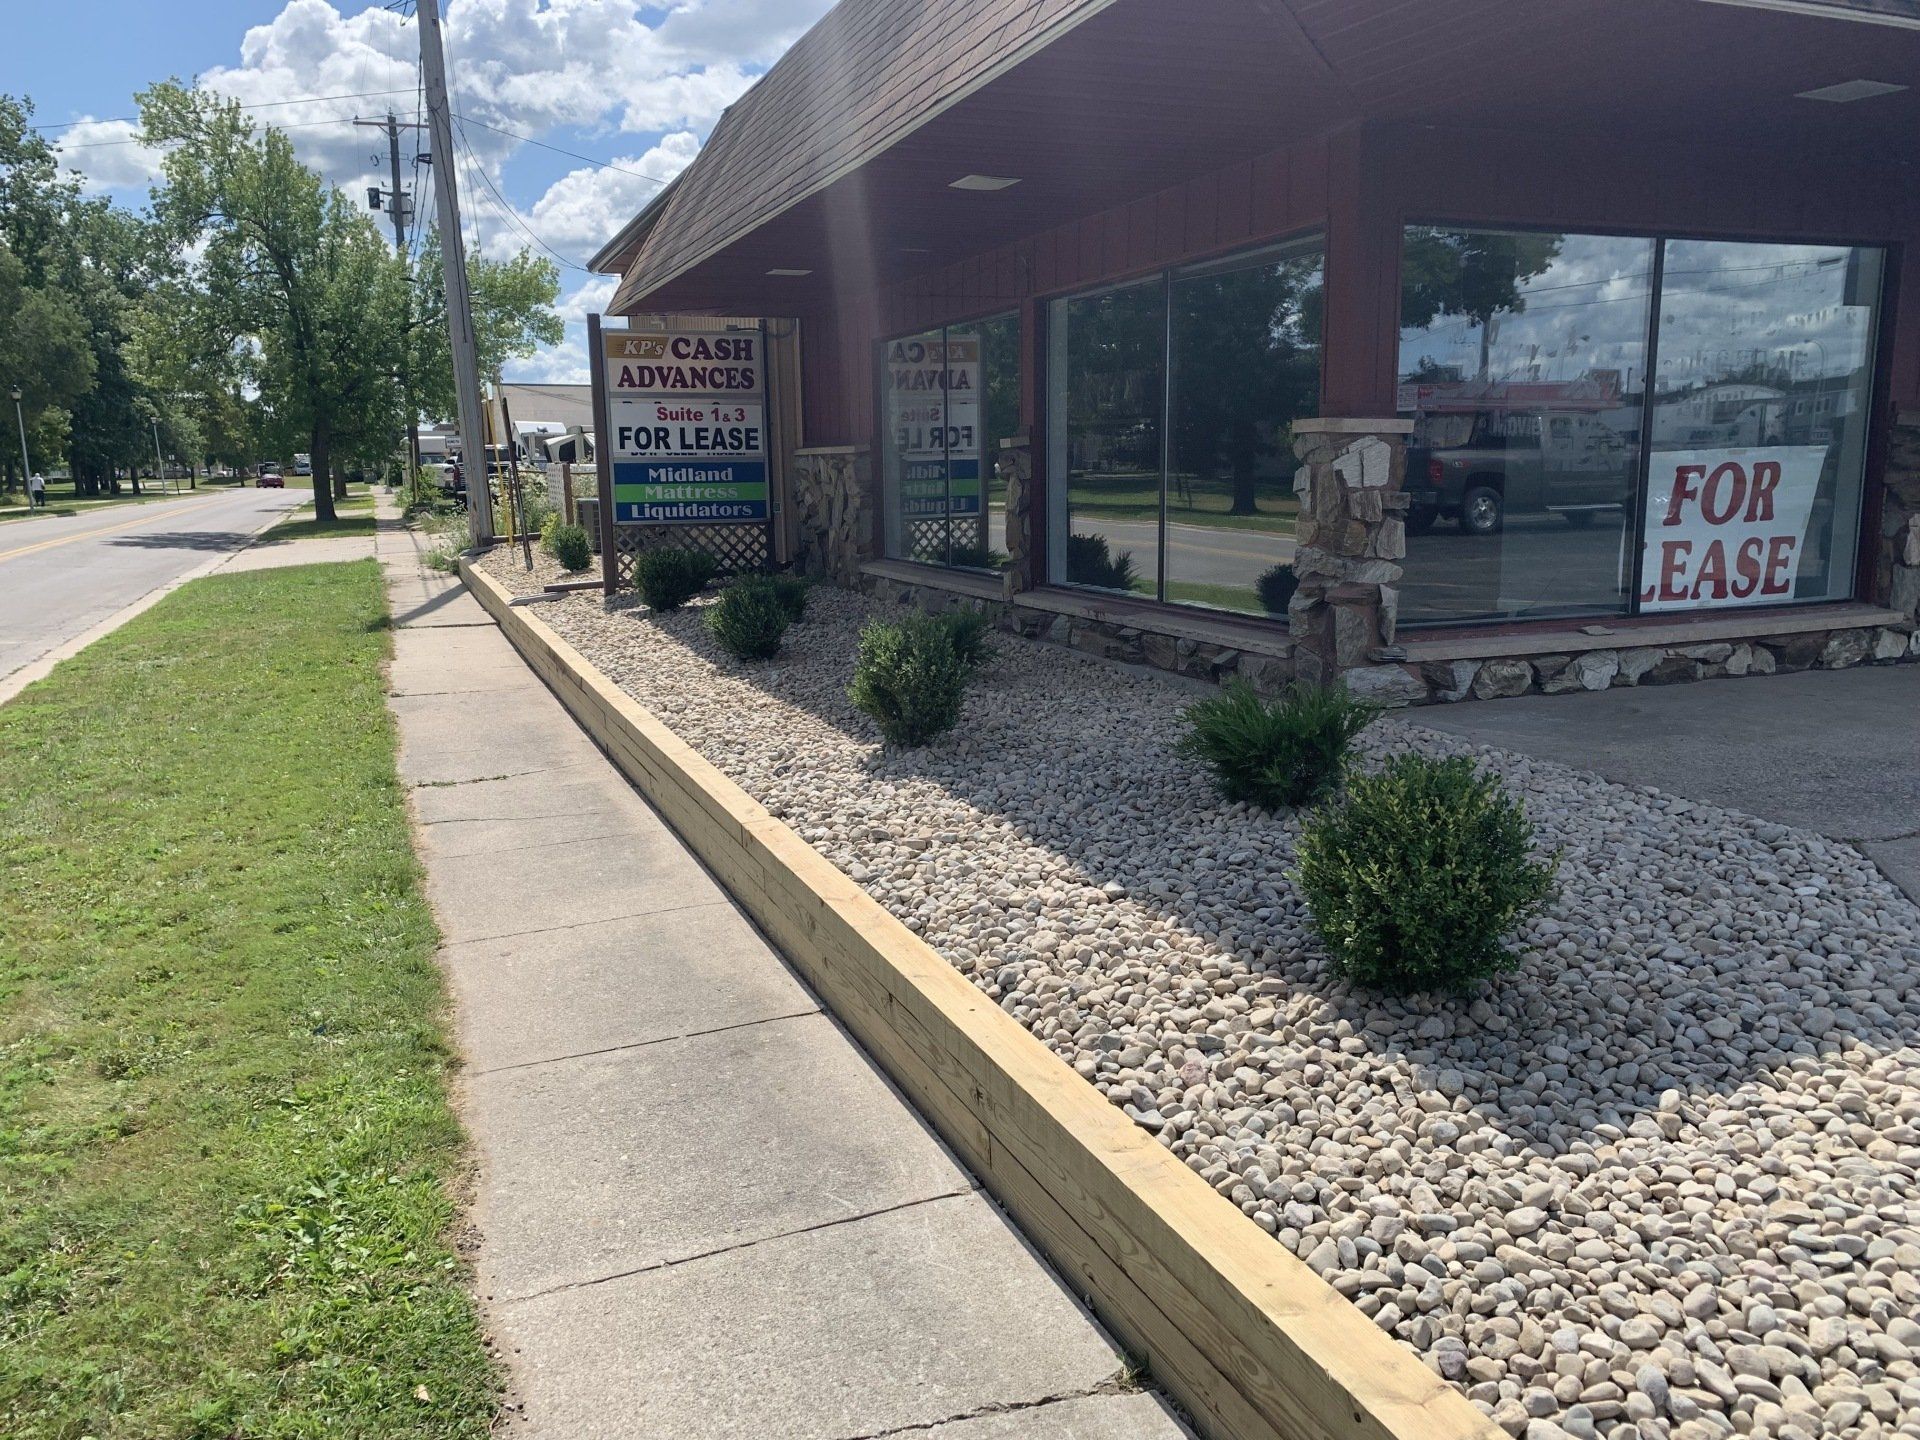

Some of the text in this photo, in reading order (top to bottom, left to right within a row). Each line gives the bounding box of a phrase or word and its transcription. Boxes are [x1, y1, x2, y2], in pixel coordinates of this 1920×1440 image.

[623, 337, 754, 361] KP's CASH
[617, 365, 755, 390] ADVANCES
[656, 406, 746, 422] Suite 1 & 3
[618, 426, 760, 451] FOR LEASE
[648, 467, 733, 482] Midland
[645, 485, 738, 500] Mattress
[1662, 461, 1782, 526] FOR
[631, 502, 753, 520] Liquidators
